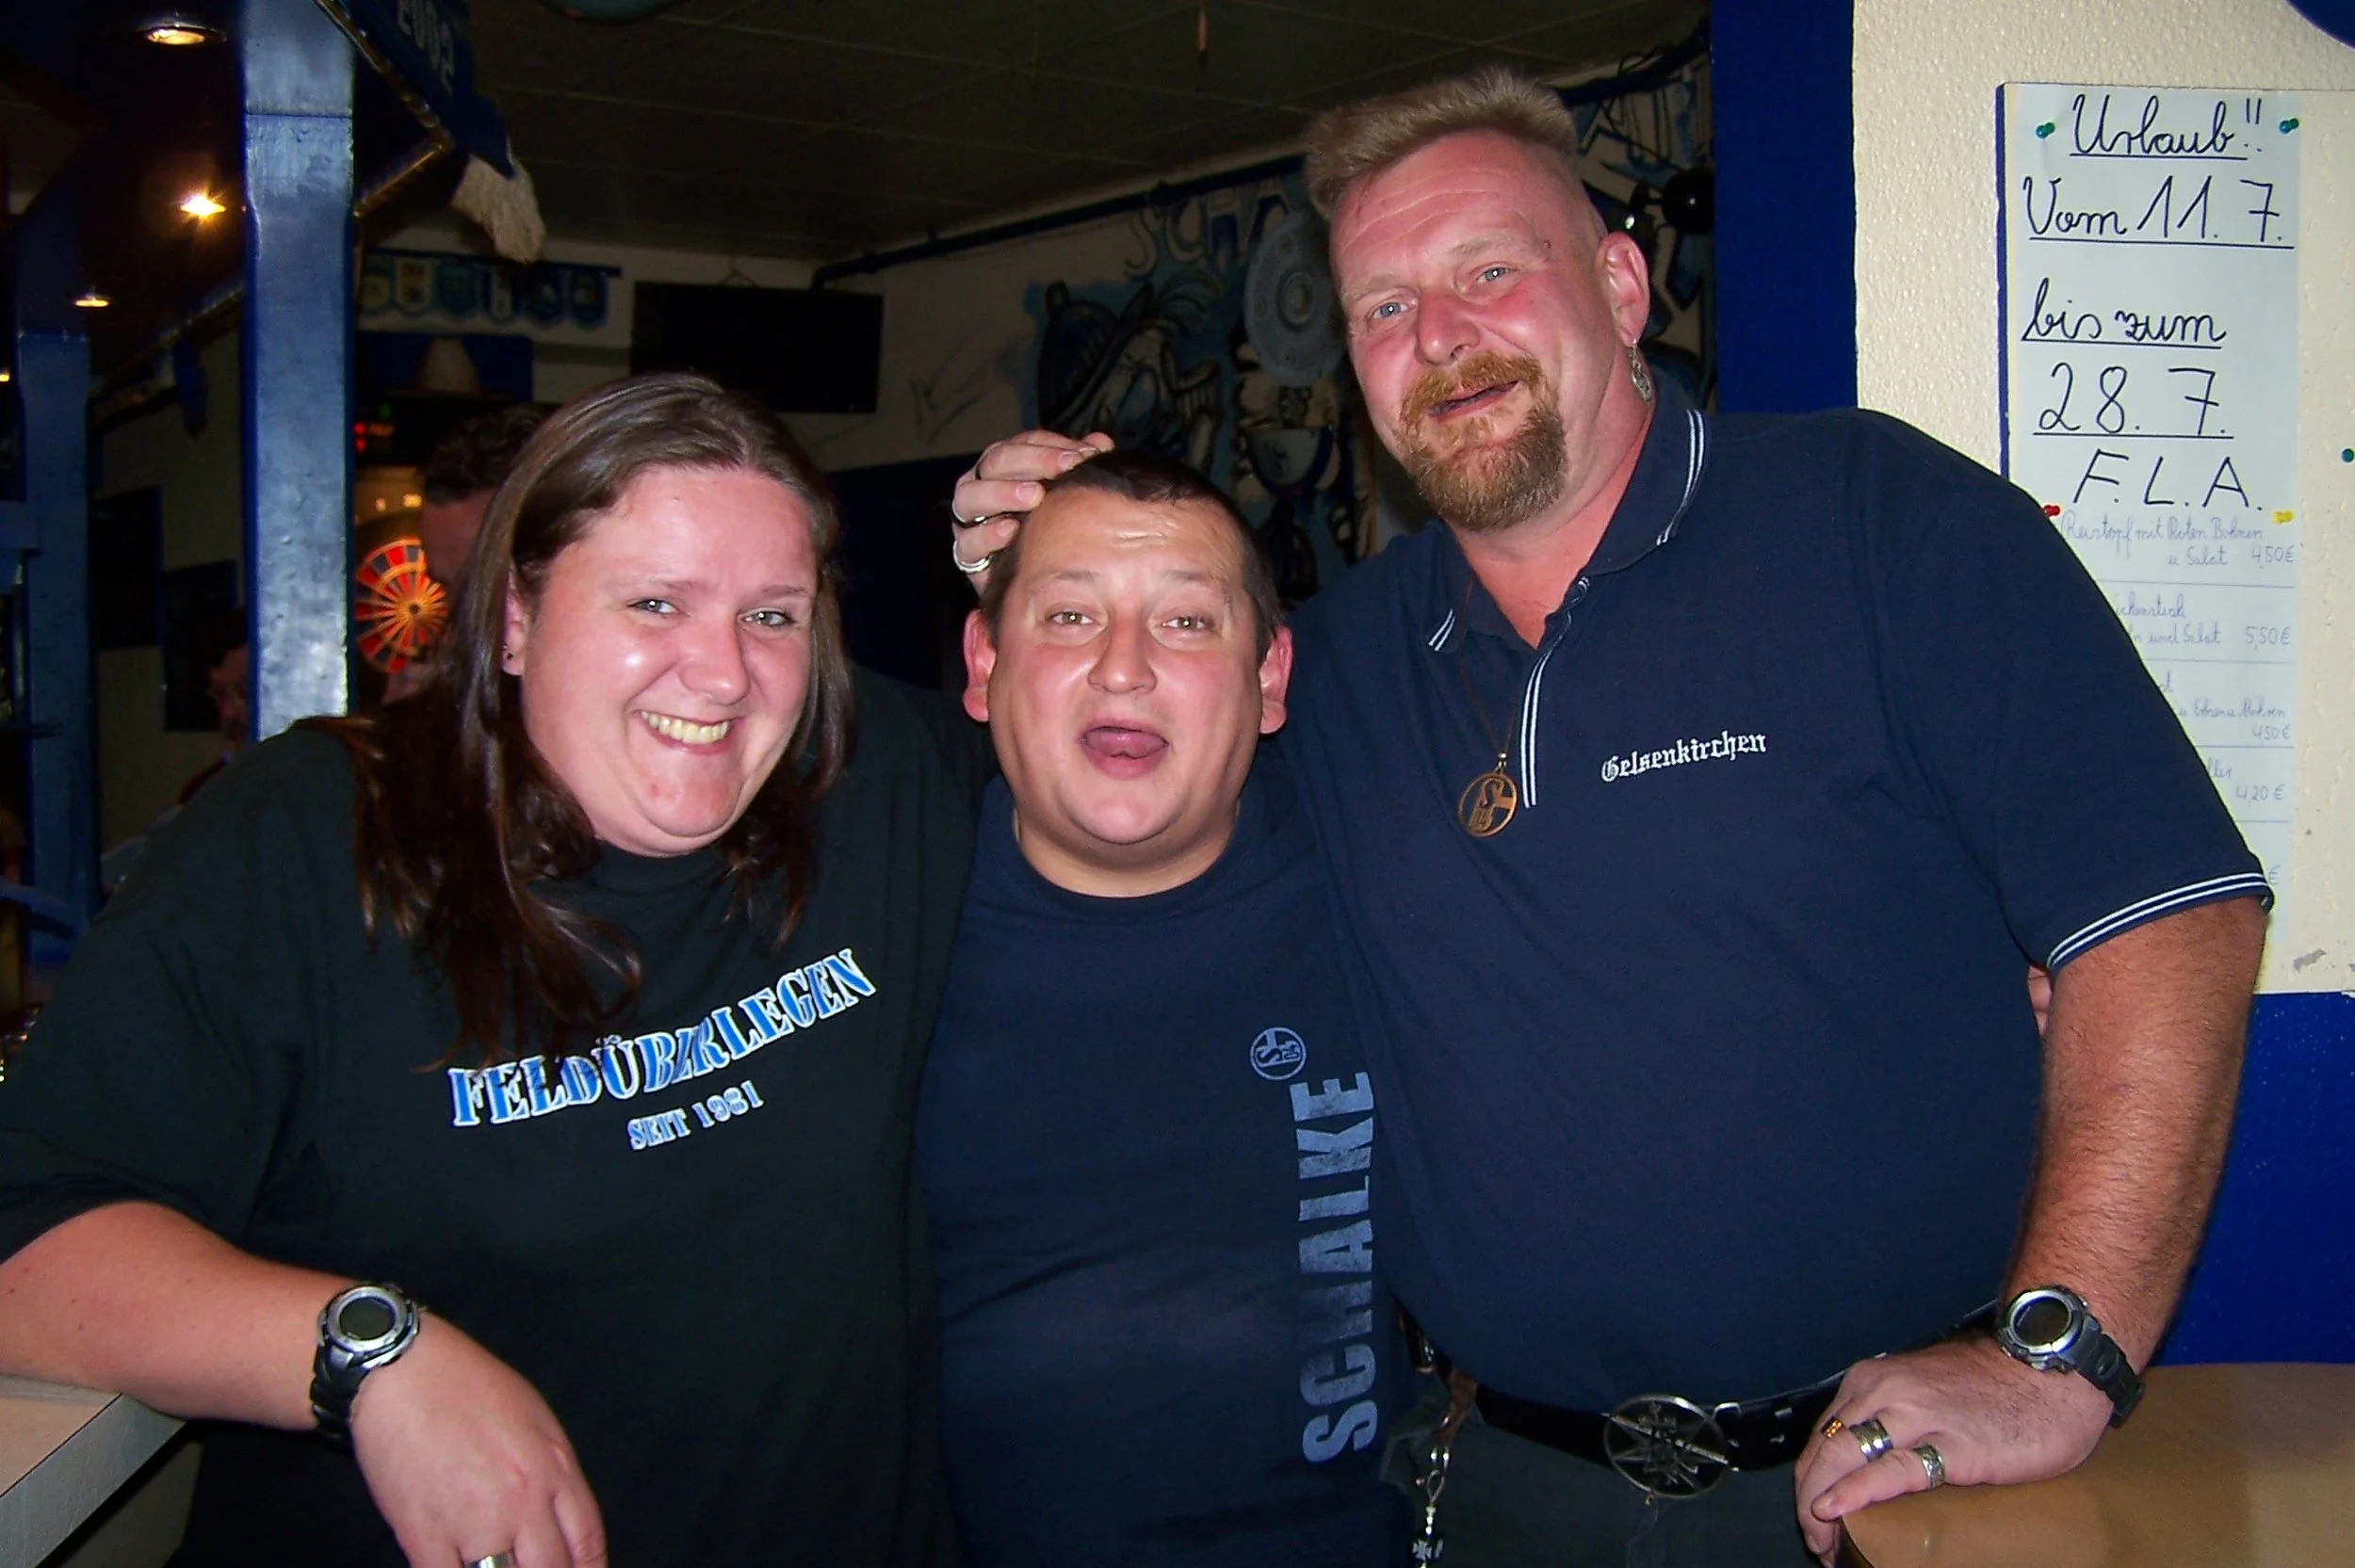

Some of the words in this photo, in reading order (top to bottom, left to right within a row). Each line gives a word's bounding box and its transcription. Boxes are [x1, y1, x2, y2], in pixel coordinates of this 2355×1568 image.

[2022, 176, 2127, 235] Vom
[2022, 277, 2103, 341] bis
[2115, 310, 2227, 342] zum
[2038, 362, 2141, 434] 28.
[2136, 516, 2164, 540] mit
[2185, 544, 2229, 566] Salat
[2148, 622, 2181, 644] und
[2183, 621, 2222, 645] Salat
[1600, 730, 1767, 783] Gelsenkirchen
[625, 1107, 690, 1152] SEIT
[690, 1079, 765, 1129] 1981
[1289, 1071, 1378, 1463] SCHALKE
